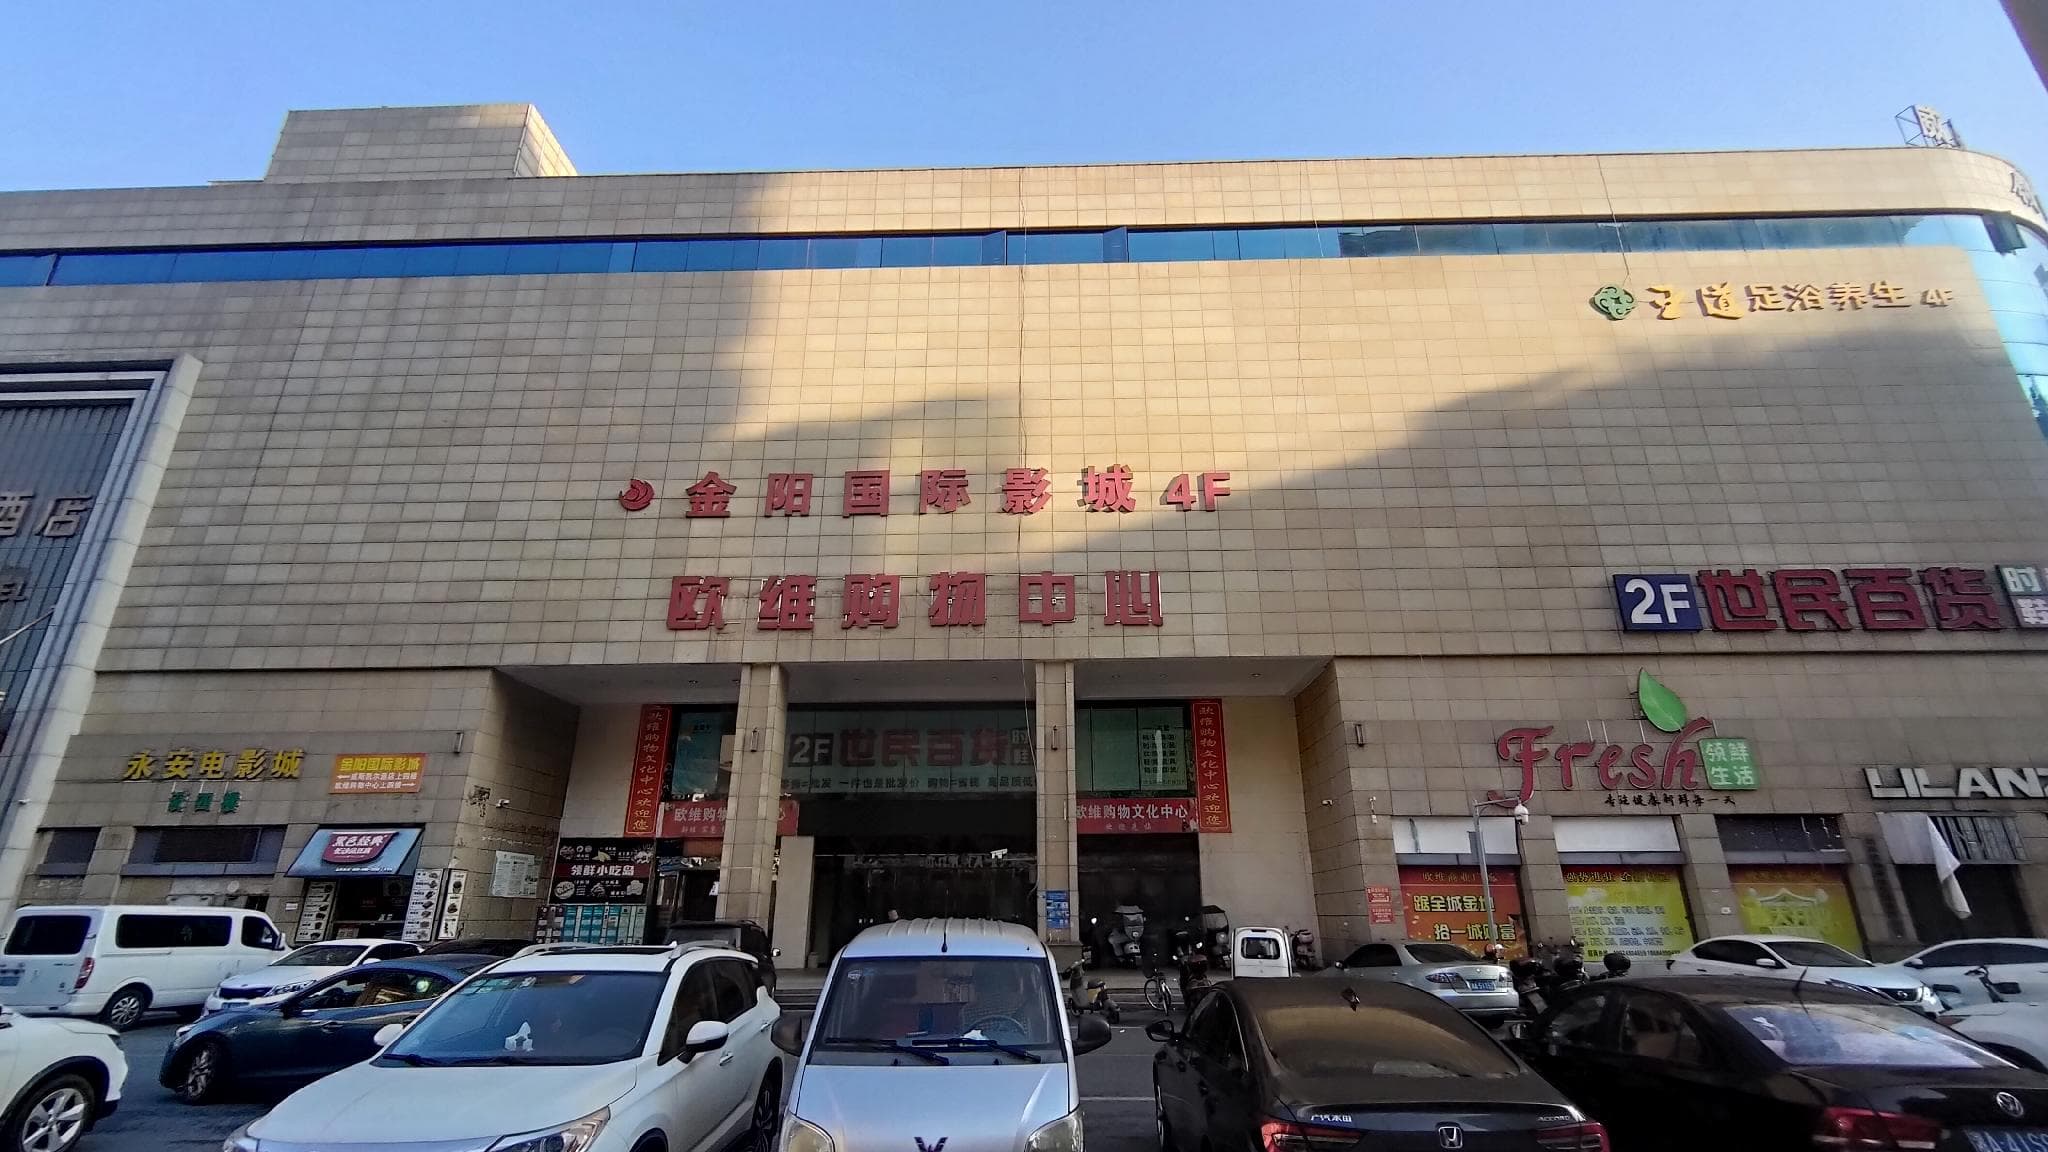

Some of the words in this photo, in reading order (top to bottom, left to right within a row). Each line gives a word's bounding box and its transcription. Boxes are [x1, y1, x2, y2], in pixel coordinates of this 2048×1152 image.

[685, 465, 1135, 518] 金阳国际影城
[1162, 471, 1231, 512] 4F
[2001, 566, 2048, 592] 时
[667, 571, 1163, 631] 欧维购物中心
[1623, 577, 1691, 625] 2F
[1701, 566, 2001, 632] 世民百货
[793, 735, 831, 764] 2F
[1487, 716, 1714, 808] Fresh
[1706, 741, 1748, 762] 领鲜
[123, 748, 304, 781] 永安电影城
[1709, 764, 1753, 786] 生活
[1077, 803, 1188, 819] 欧维购物文化中心
[570, 864, 635, 876] 领鲜小吃岛
